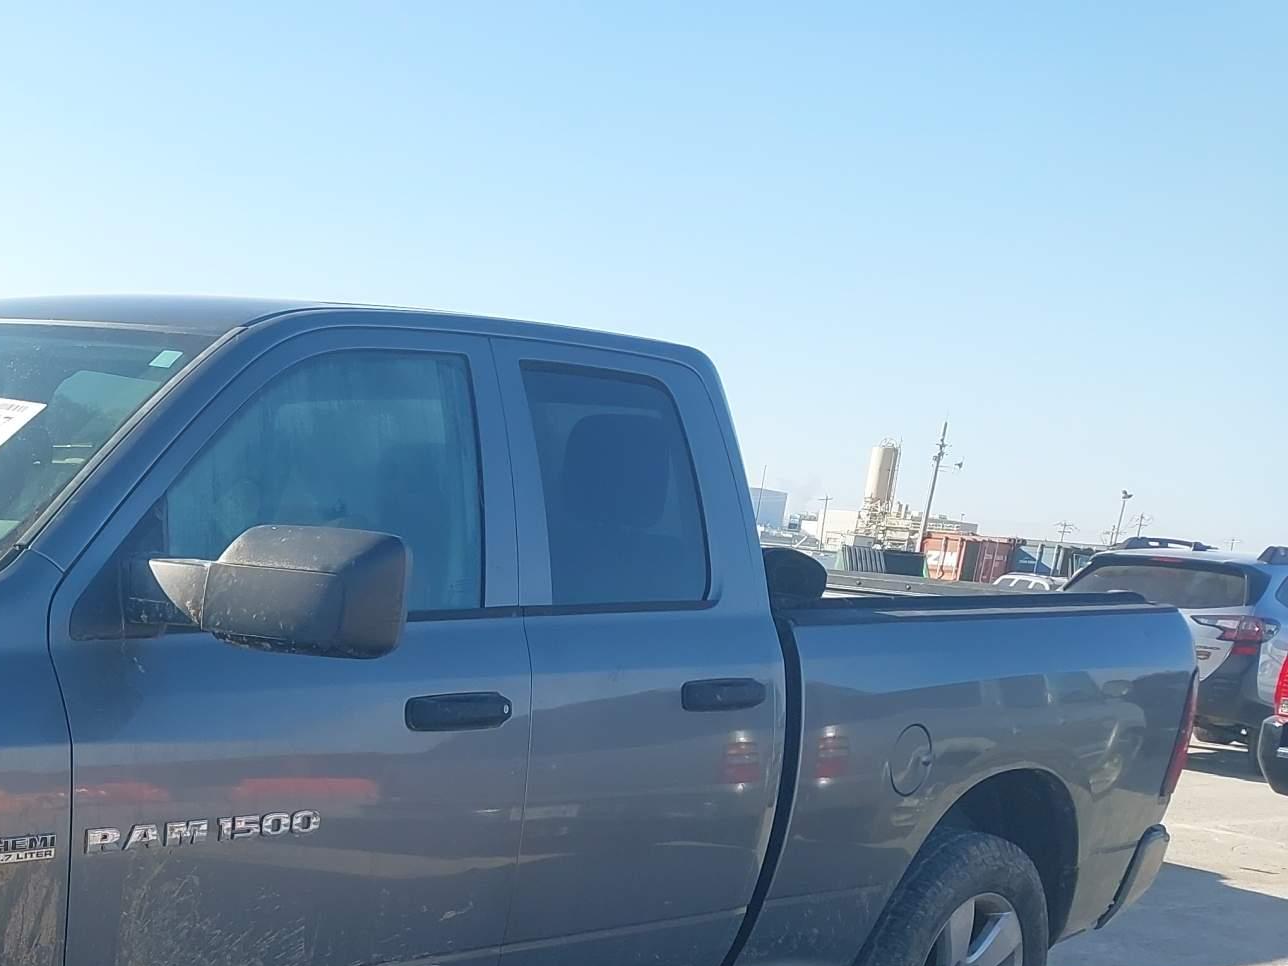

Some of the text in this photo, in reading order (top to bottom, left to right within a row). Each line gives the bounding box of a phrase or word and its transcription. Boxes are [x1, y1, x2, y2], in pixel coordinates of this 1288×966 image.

[84, 809, 321, 854] RAM 1500
[16, 849, 53, 861] LITER
